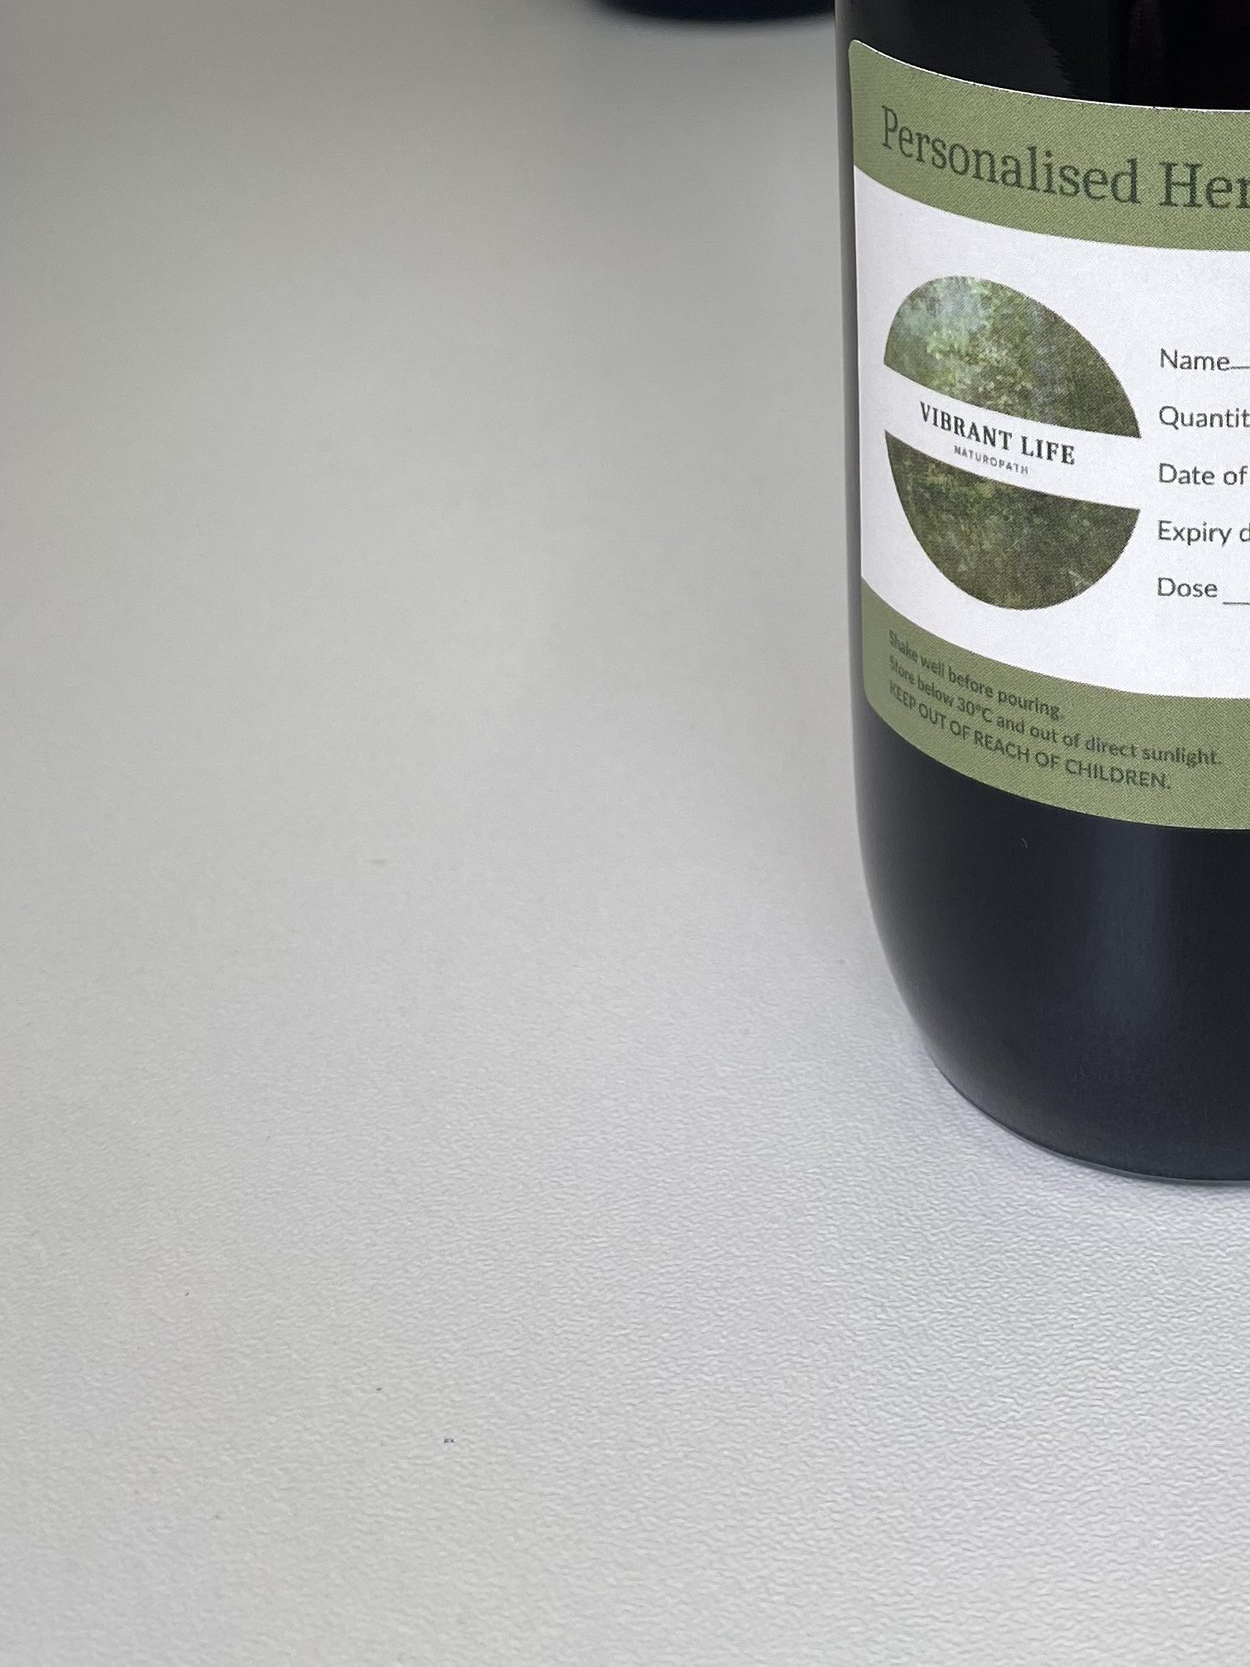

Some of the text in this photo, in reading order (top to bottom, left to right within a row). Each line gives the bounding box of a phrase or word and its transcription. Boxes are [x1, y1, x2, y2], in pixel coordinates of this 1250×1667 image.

[880, 104, 1141, 206] Personalised
[1159, 347, 1231, 371] Name
[920, 401, 1075, 465] VIBRANT LIFE
[953, 445, 1029, 475] NATUROPATH
[1158, 463, 1215, 485] Date
[1223, 465, 1248, 485] of
[1157, 520, 1232, 547] Expiry
[1157, 576, 1218, 598] Dose
[889, 629, 1063, 722] Shake well before pouring.
[889, 655, 915, 685] Store
[918, 674, 954, 708] below
[997, 715, 1025, 735] and
[1030, 725, 1057, 744] out
[1063, 733, 1081, 749] of
[1085, 736, 1138, 759] direct
[1142, 745, 1222, 769] sunlight.
[889, 680, 1171, 791] KEEP OUT OF REACH OF CHILDREN.
